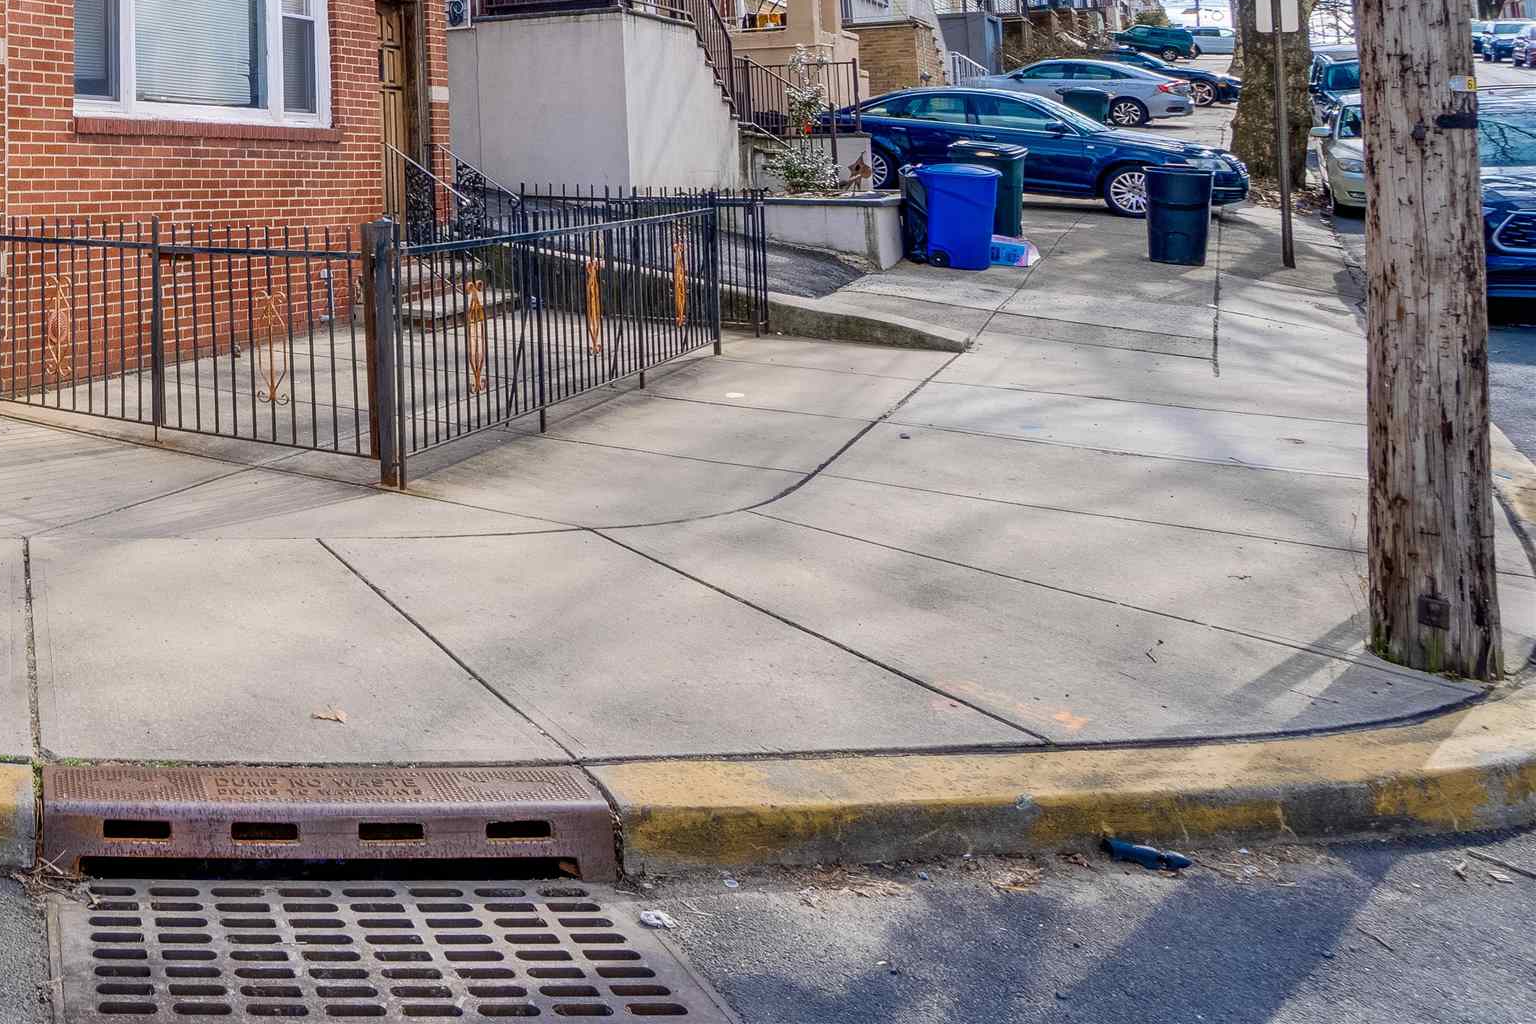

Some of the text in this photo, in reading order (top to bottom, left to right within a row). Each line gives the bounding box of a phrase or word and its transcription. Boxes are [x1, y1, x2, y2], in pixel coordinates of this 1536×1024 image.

[214, 778, 417, 788] DUMP NO WASTE
[287, 788, 310, 796] TO
